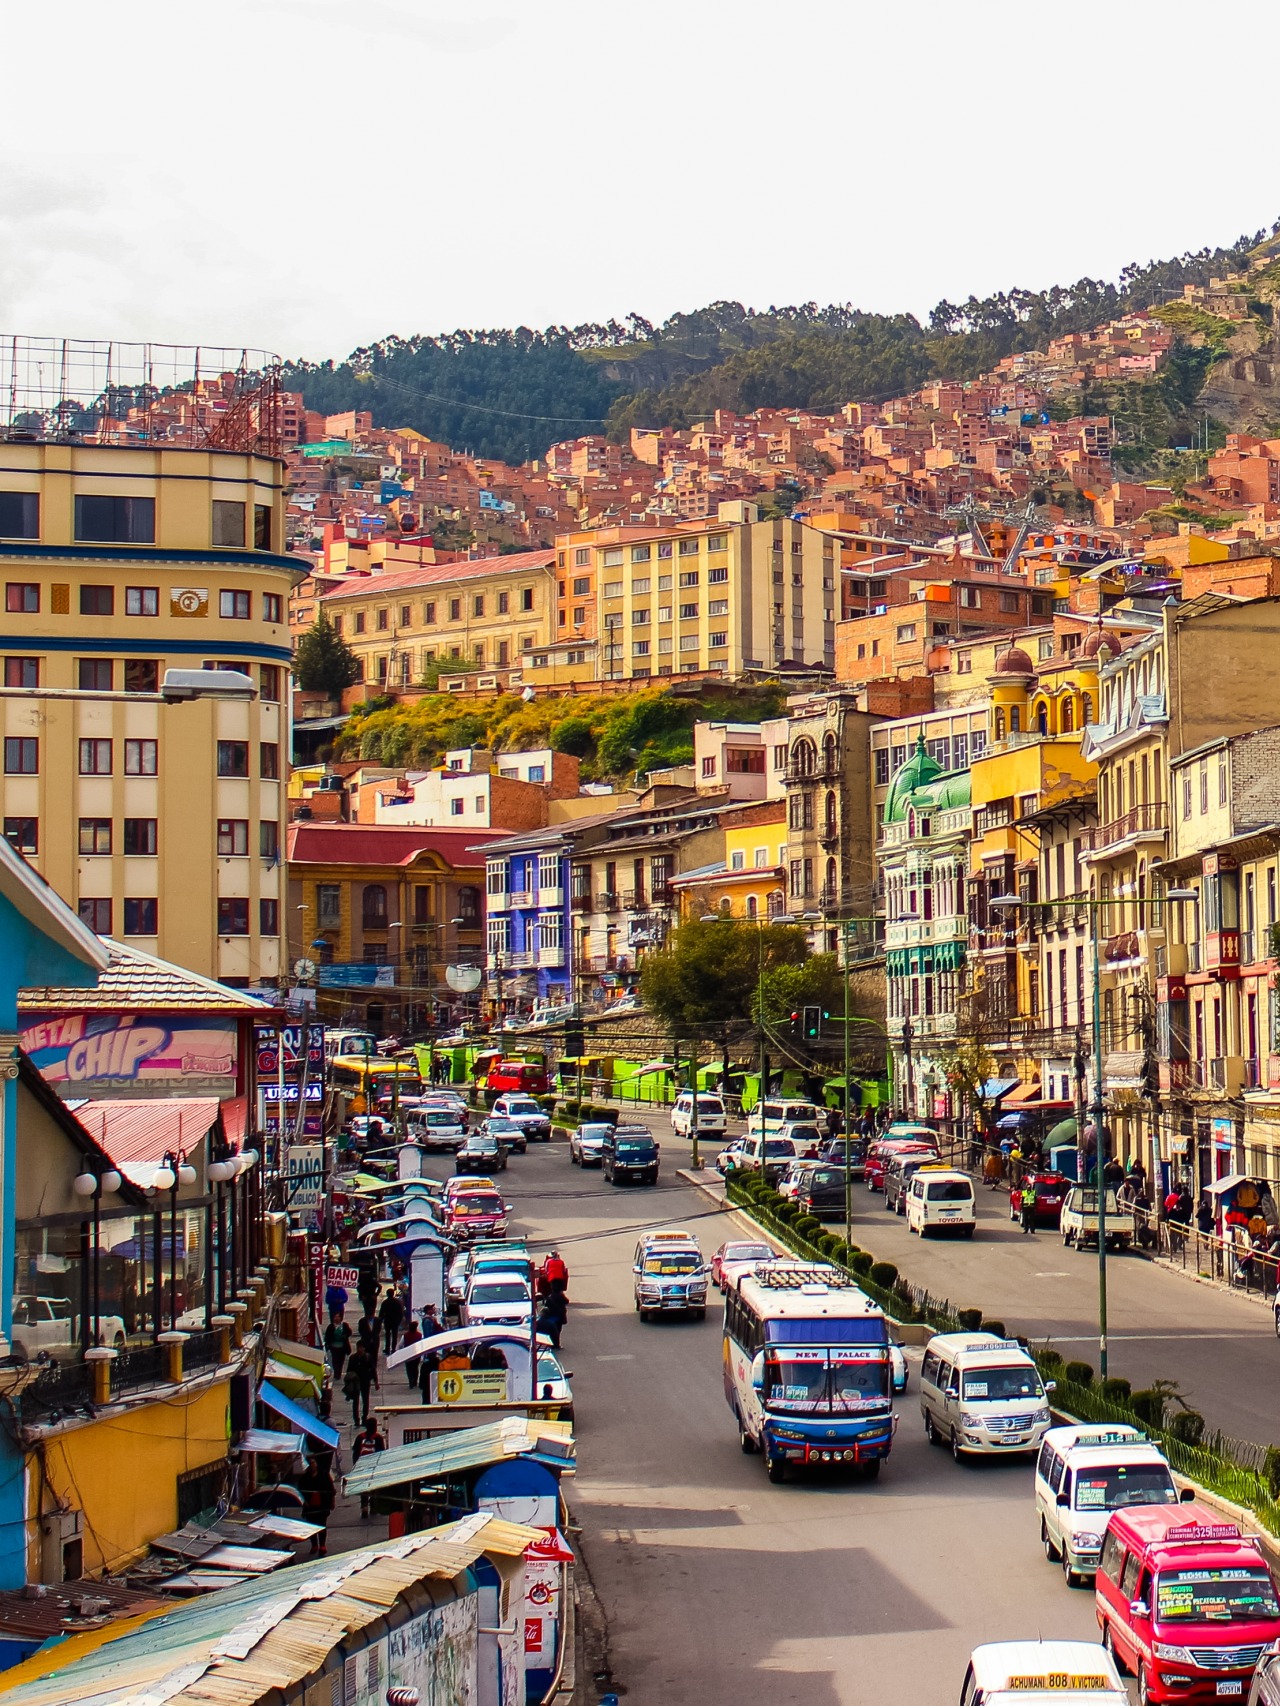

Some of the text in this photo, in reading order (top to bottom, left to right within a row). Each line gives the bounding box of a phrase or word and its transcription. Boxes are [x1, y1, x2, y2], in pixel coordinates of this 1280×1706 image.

[1195, 1526, 1211, 1538] 325
[1159, 1593, 1194, 1601] PRADO
[1010, 1677, 1045, 1689] ACHUMANI
[1048, 1674, 1068, 1688] 808
